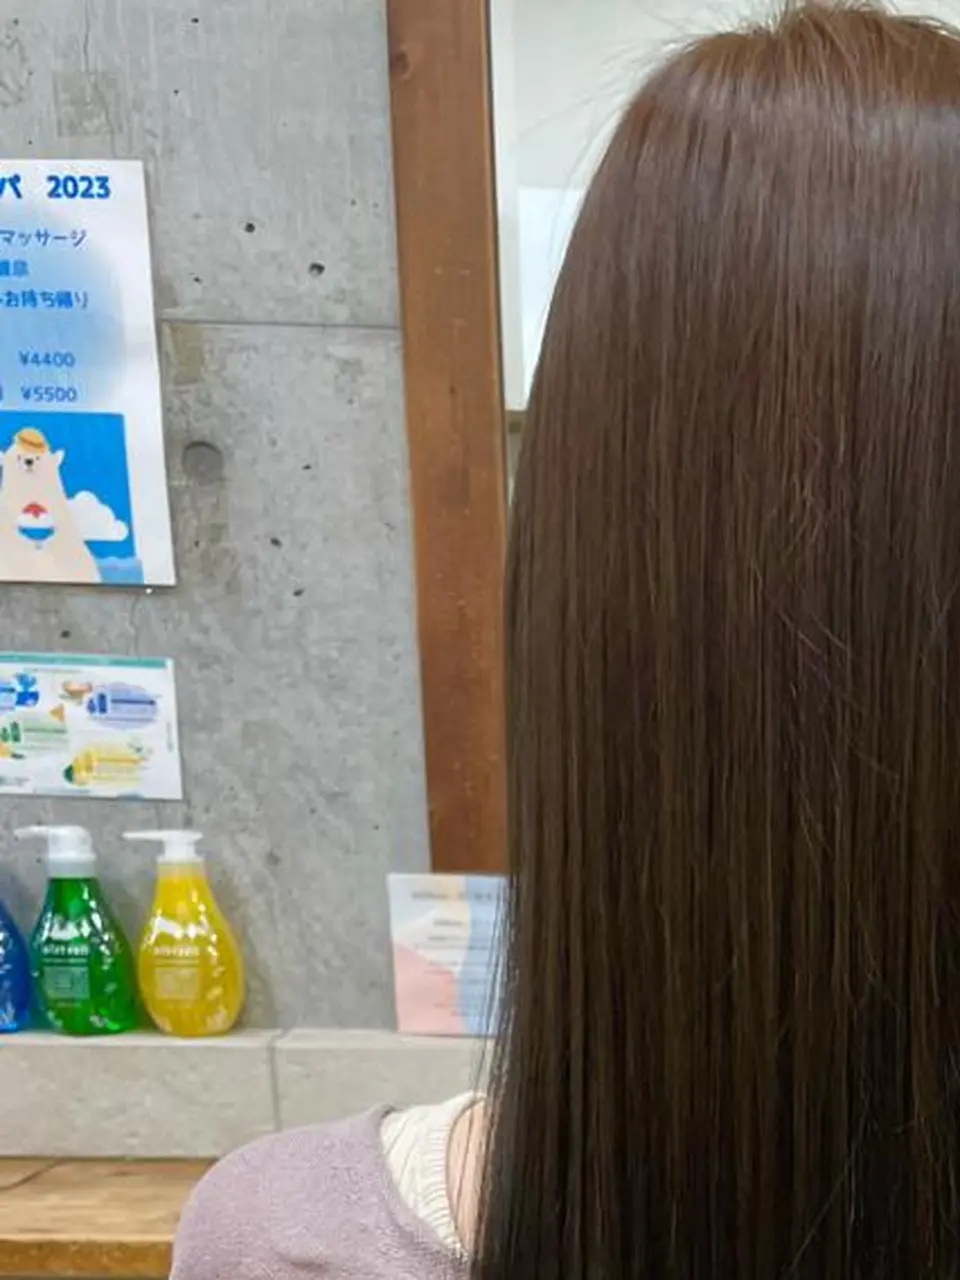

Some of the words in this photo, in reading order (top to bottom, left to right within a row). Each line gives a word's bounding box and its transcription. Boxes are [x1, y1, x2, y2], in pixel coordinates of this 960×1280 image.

[46, 175, 111, 199] 2023
[0, 289, 88, 309] お持ち帰り
[19, 351, 76, 367] ¥4400
[21, 386, 78, 401] ¥5500
